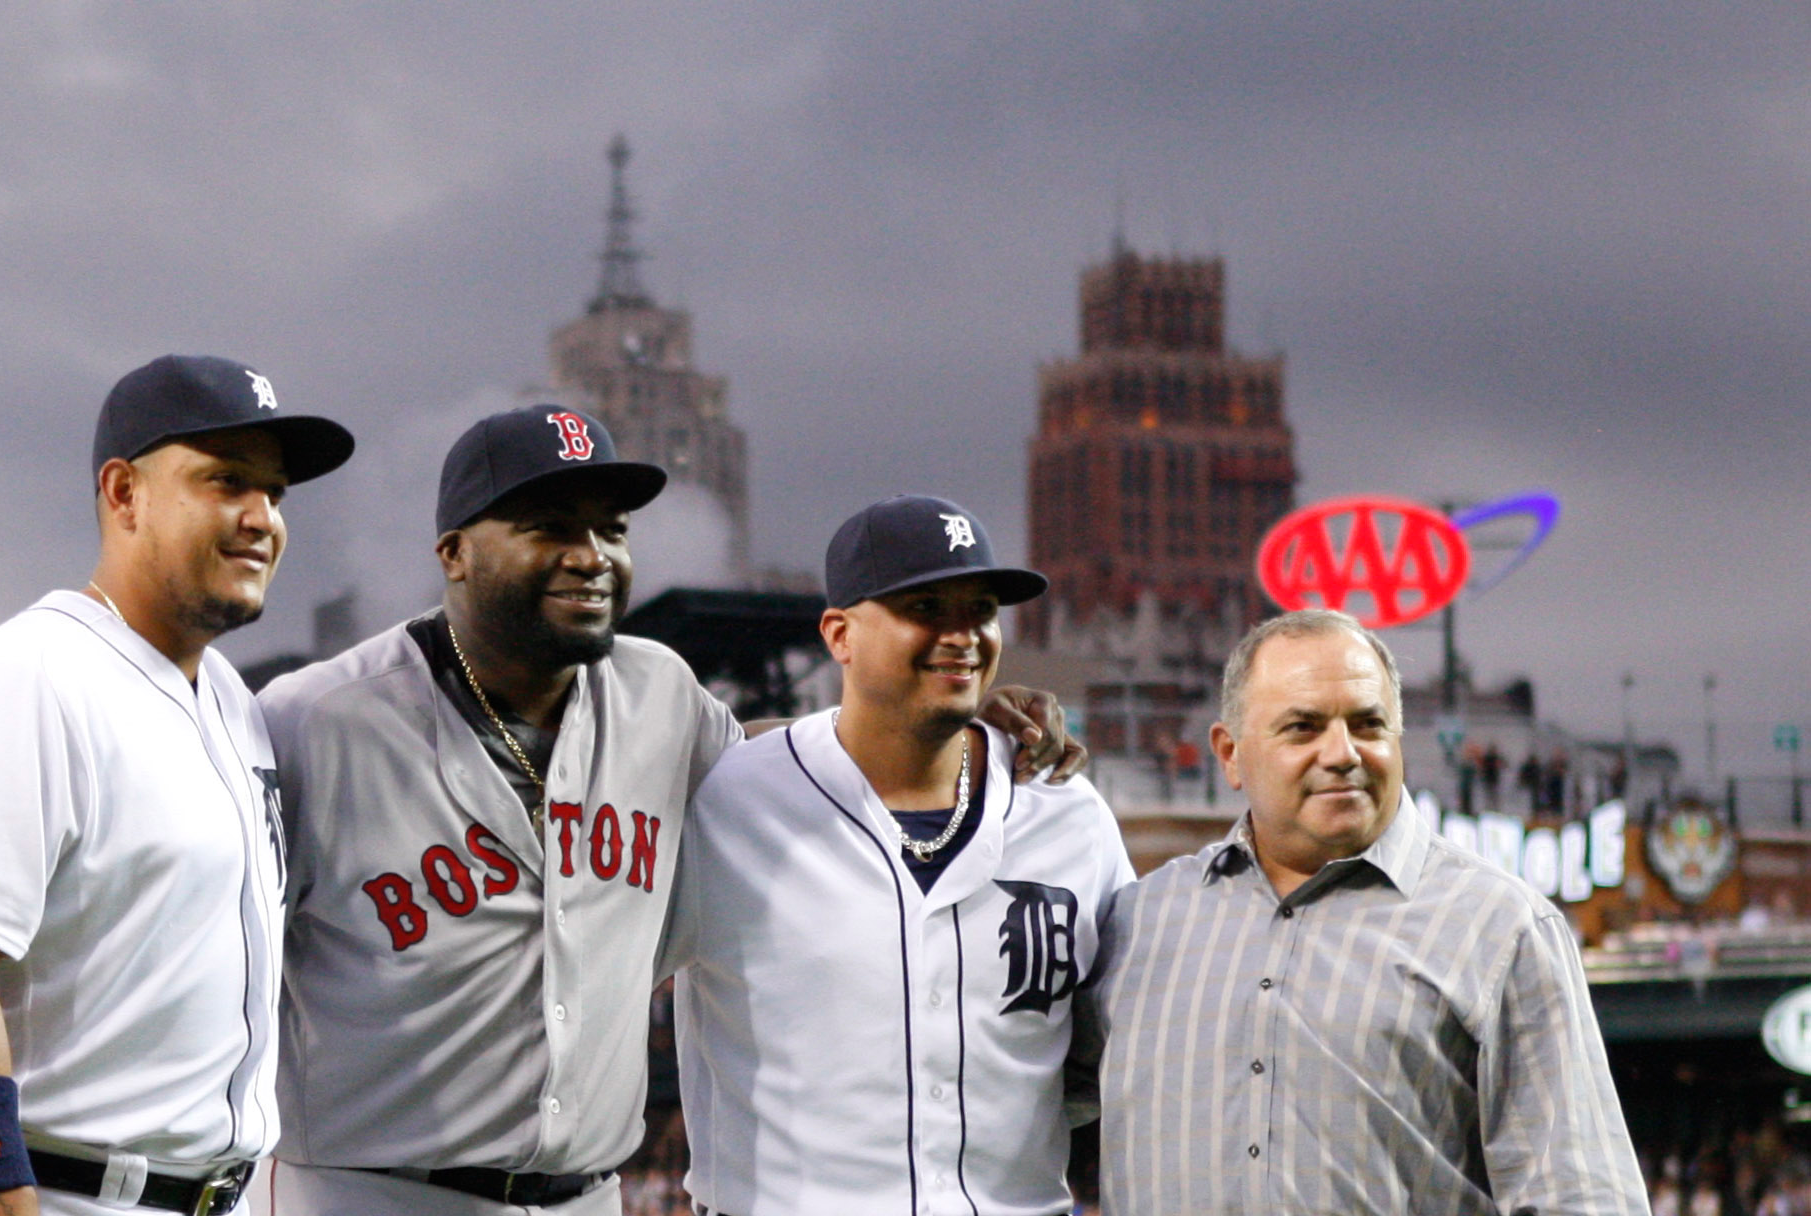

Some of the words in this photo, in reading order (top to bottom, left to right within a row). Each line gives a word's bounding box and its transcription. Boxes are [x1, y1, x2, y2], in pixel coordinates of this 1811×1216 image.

[546, 411, 594, 461] B
[1274, 503, 1451, 622] AAA
[361, 798, 661, 953] BOSTON
[993, 878, 1079, 1027] D
